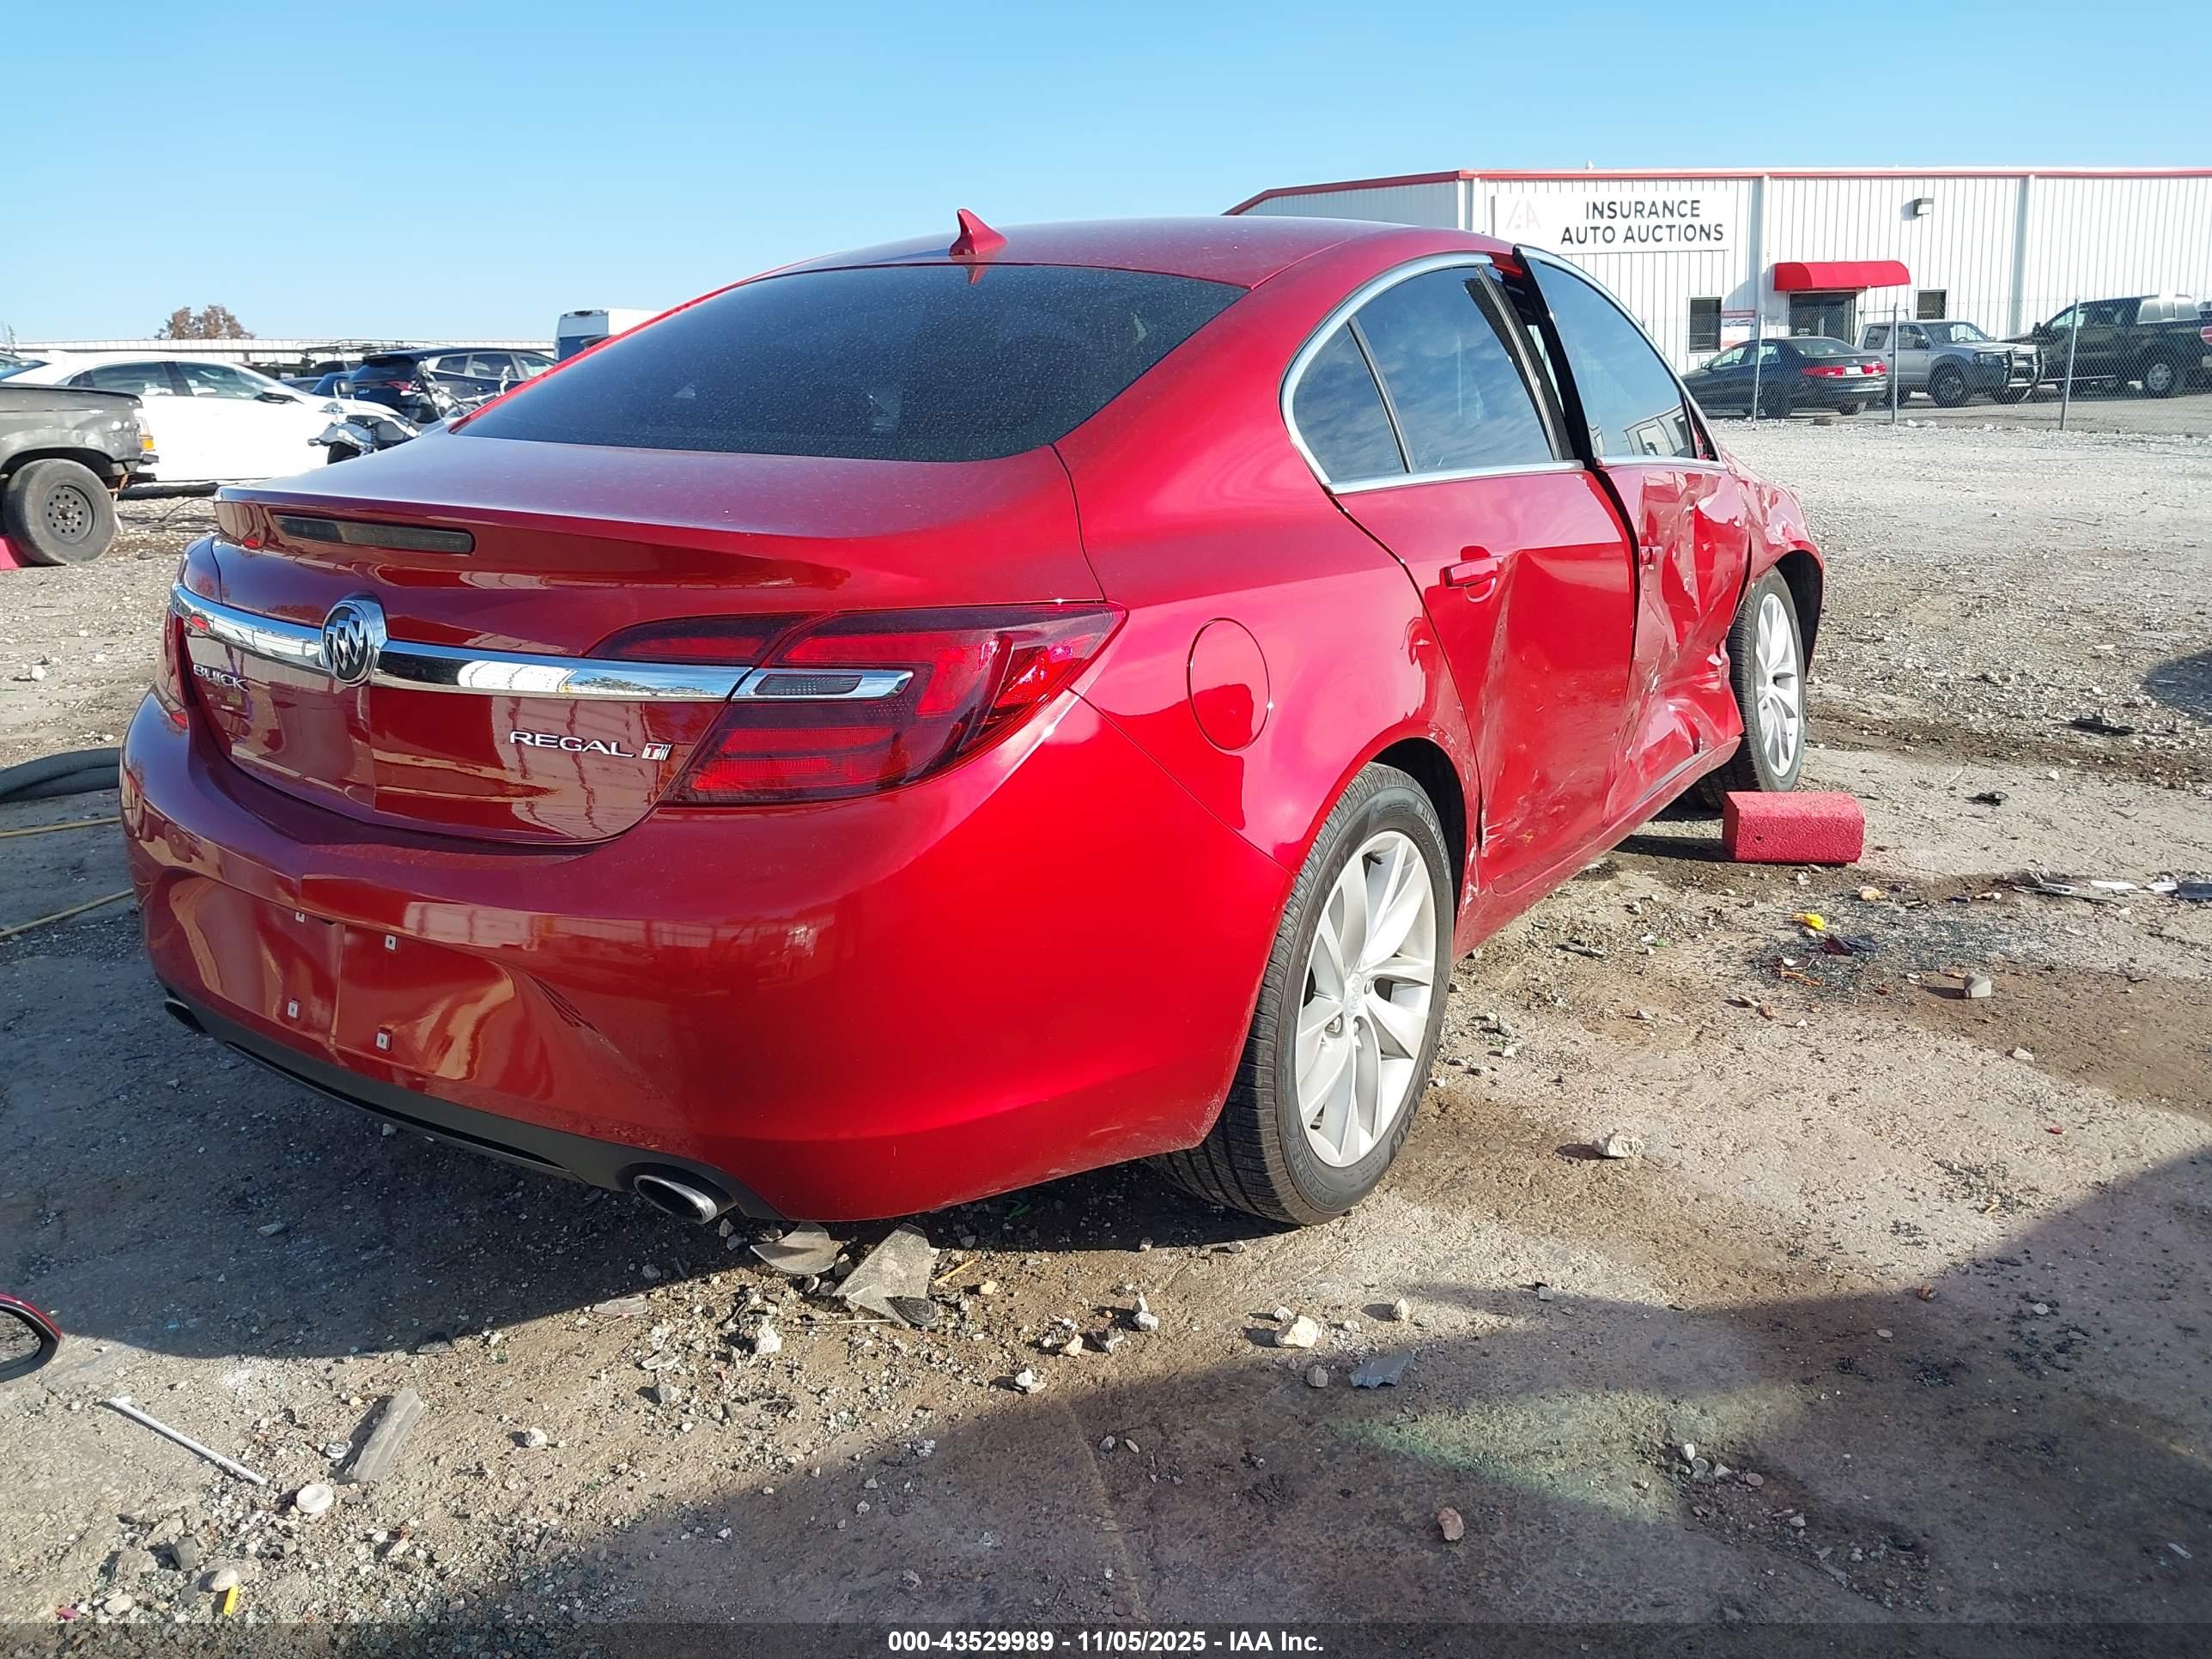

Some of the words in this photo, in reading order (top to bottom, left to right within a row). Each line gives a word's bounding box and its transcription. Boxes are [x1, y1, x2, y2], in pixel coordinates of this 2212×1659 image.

[1586, 200, 1701, 220] INSURANCE
[1560, 227, 1616, 245] AUTO
[1623, 223, 1724, 244] AUCTIONS
[193, 664, 250, 693] BUICK
[509, 731, 635, 758] REGAL
